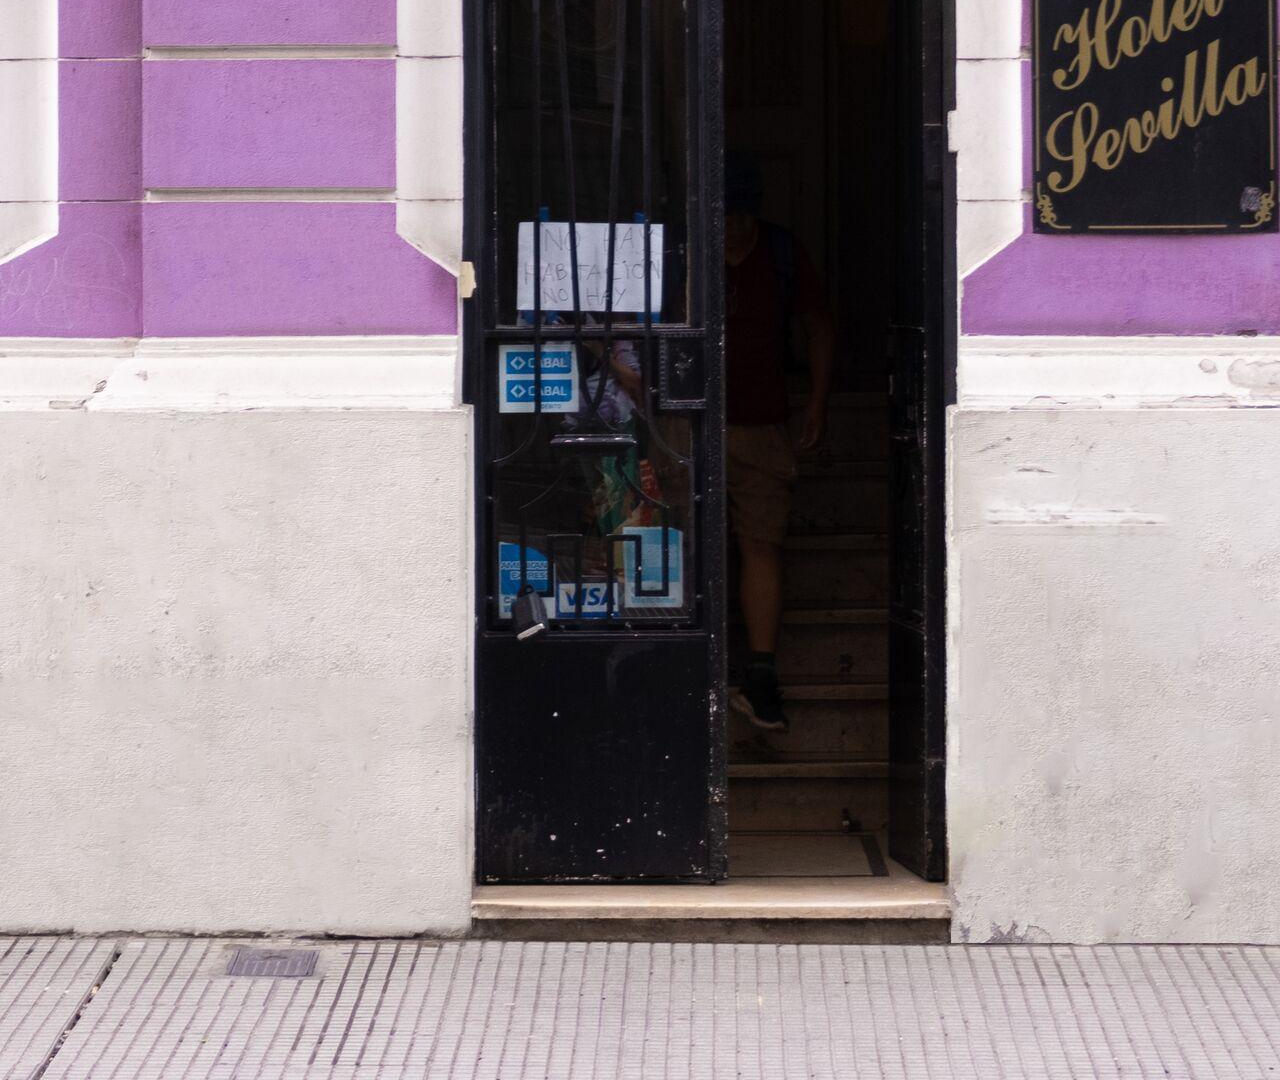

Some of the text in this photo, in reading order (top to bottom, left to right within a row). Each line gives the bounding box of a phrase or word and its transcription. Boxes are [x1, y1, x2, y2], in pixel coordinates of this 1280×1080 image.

[1046, 38, 1267, 194] Sevilla
[544, 226, 580, 251] NO
[543, 288, 569, 304] NO
[565, 588, 616, 606] VISA
